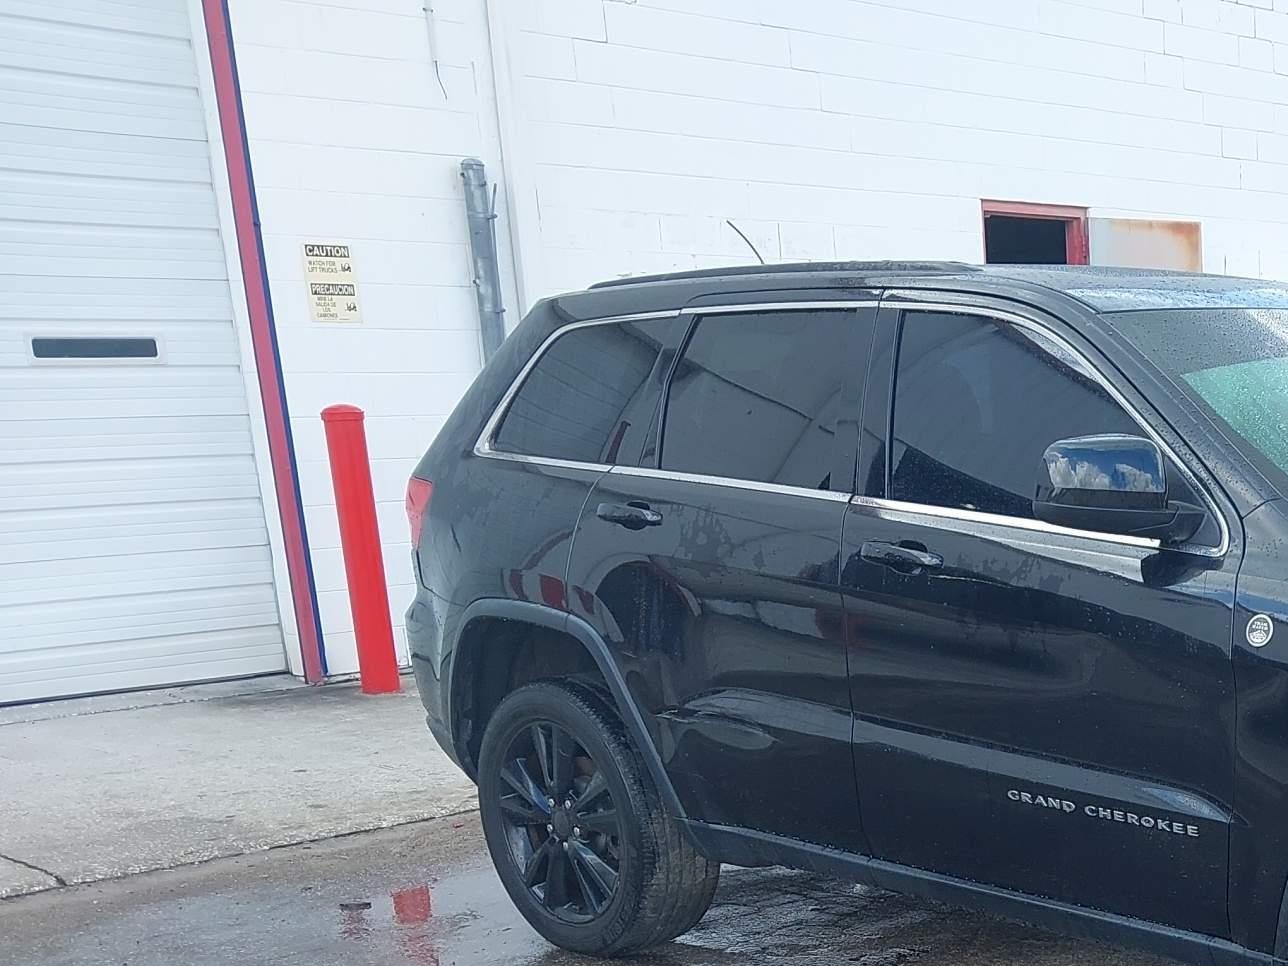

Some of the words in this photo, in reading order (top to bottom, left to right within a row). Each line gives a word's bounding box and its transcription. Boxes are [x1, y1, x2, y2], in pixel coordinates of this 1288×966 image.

[306, 245, 349, 257] CAUTION
[311, 283, 355, 296] PRECAUCION
[1007, 789, 1076, 814] GRAND
[1084, 805, 1200, 837] CHEROKEE
